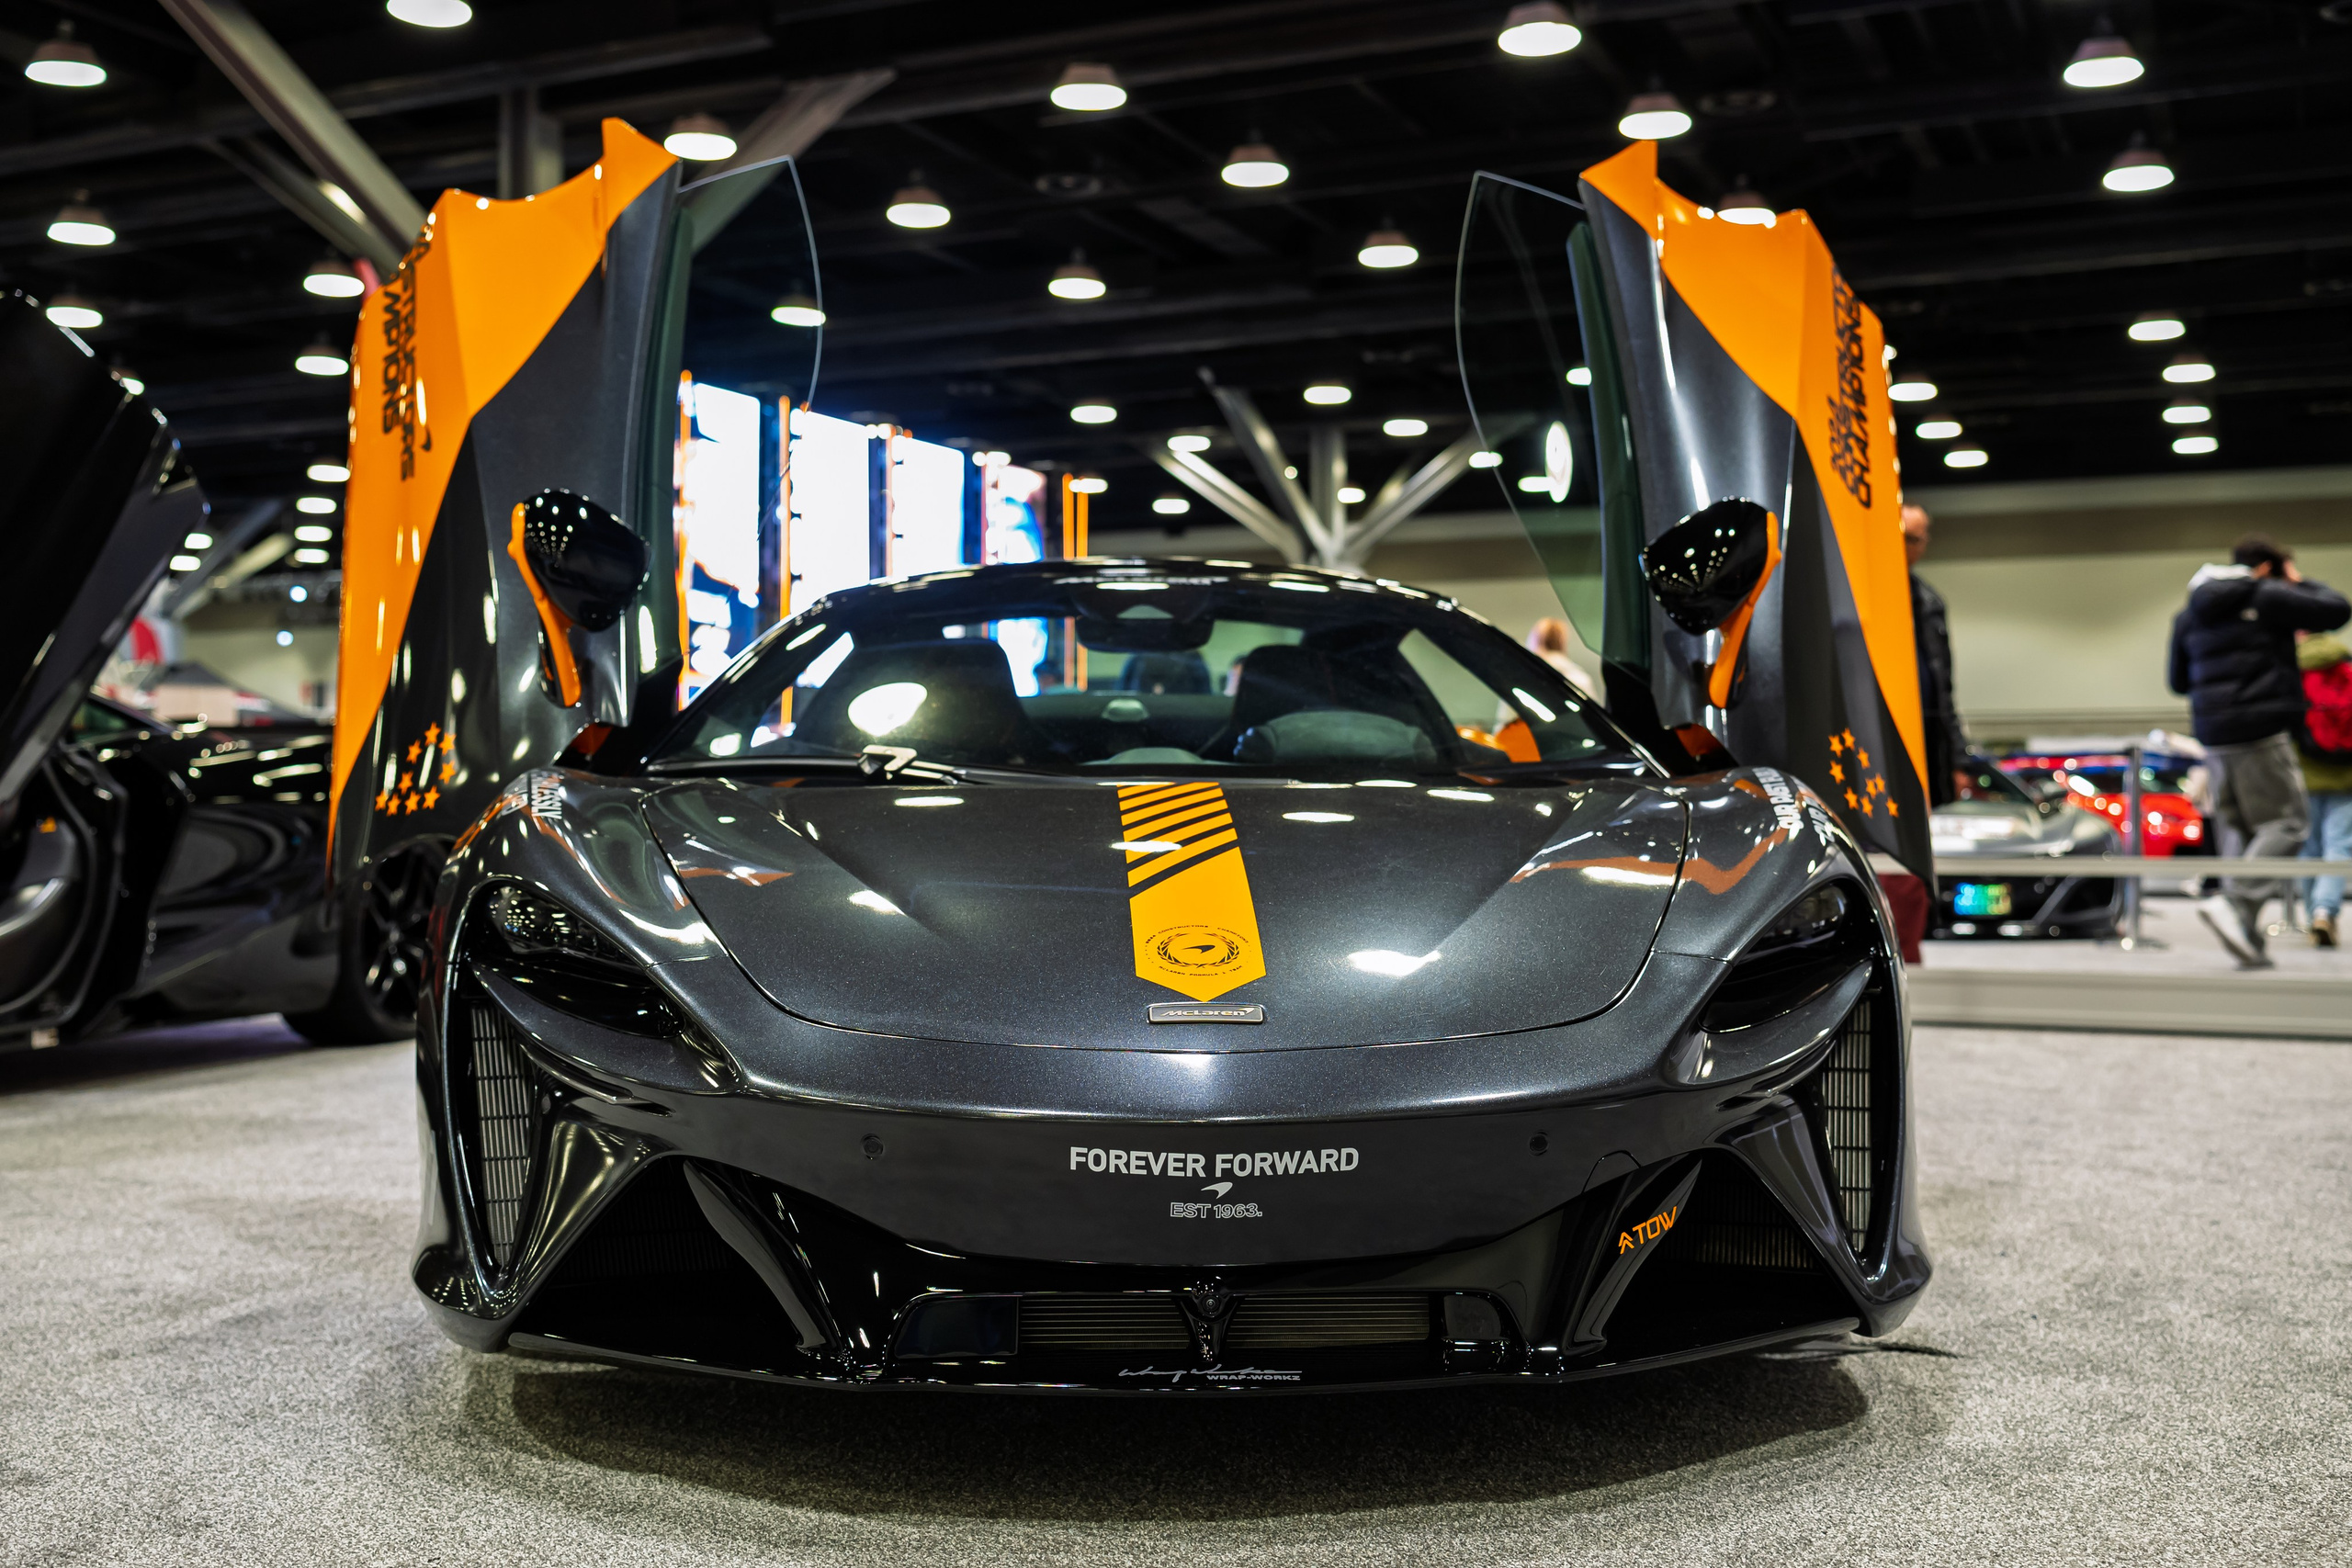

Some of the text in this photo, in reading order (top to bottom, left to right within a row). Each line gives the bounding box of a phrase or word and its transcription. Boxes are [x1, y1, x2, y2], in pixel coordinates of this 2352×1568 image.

[1160, 1009, 1247, 1018] McLaren
[1069, 1146, 1360, 1178] FOREVER FORWARD
[1170, 1201, 1263, 1219] EST 1963.
[1632, 1205, 1678, 1245] TOW
